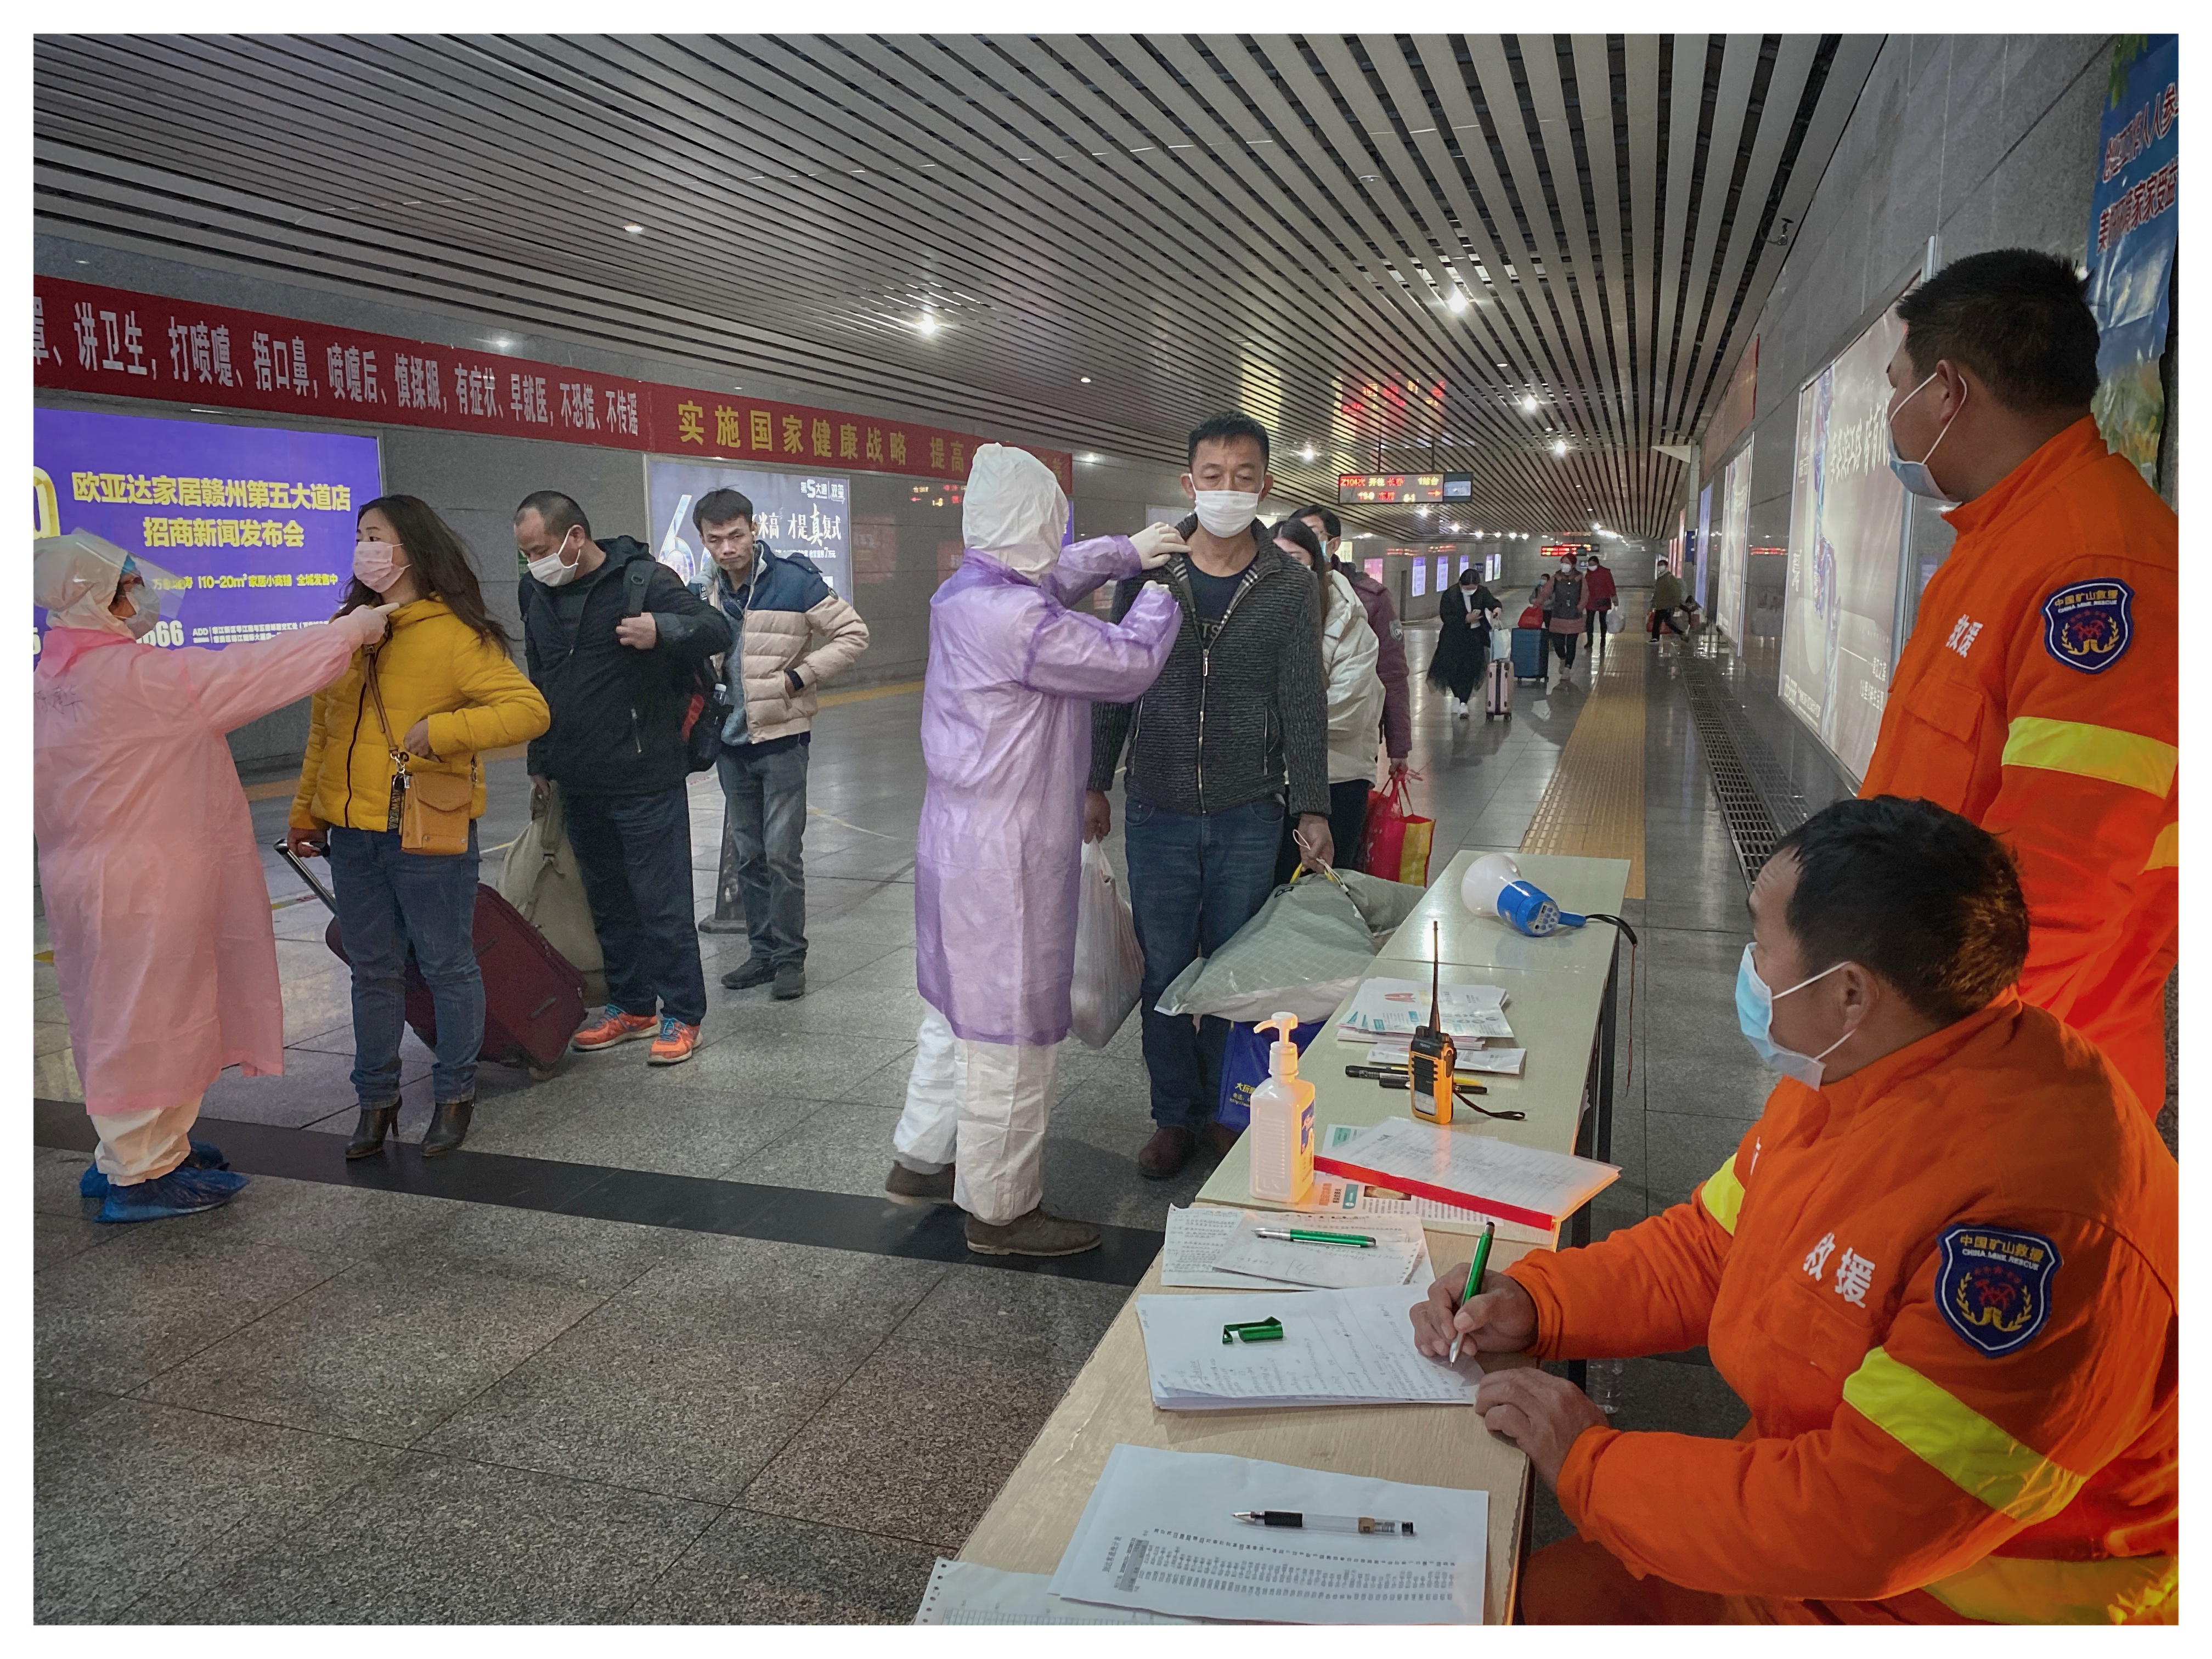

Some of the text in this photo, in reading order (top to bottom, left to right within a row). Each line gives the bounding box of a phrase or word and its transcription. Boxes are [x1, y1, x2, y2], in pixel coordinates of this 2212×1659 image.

[678, 400, 907, 466] 实施国家健康战略
[72, 471, 351, 511] 欧亚达家居赣州第五大道店
[143, 516, 305, 548] 招商新闻发布会
[752, 511, 780, 539] 米高
[192, 627, 208, 637] ADD
[1960, 1234, 2044, 1262] 中国矿山救援
[1962, 1249, 1985, 1257] CHINA
[1988, 1251, 2007, 1262] MINE
